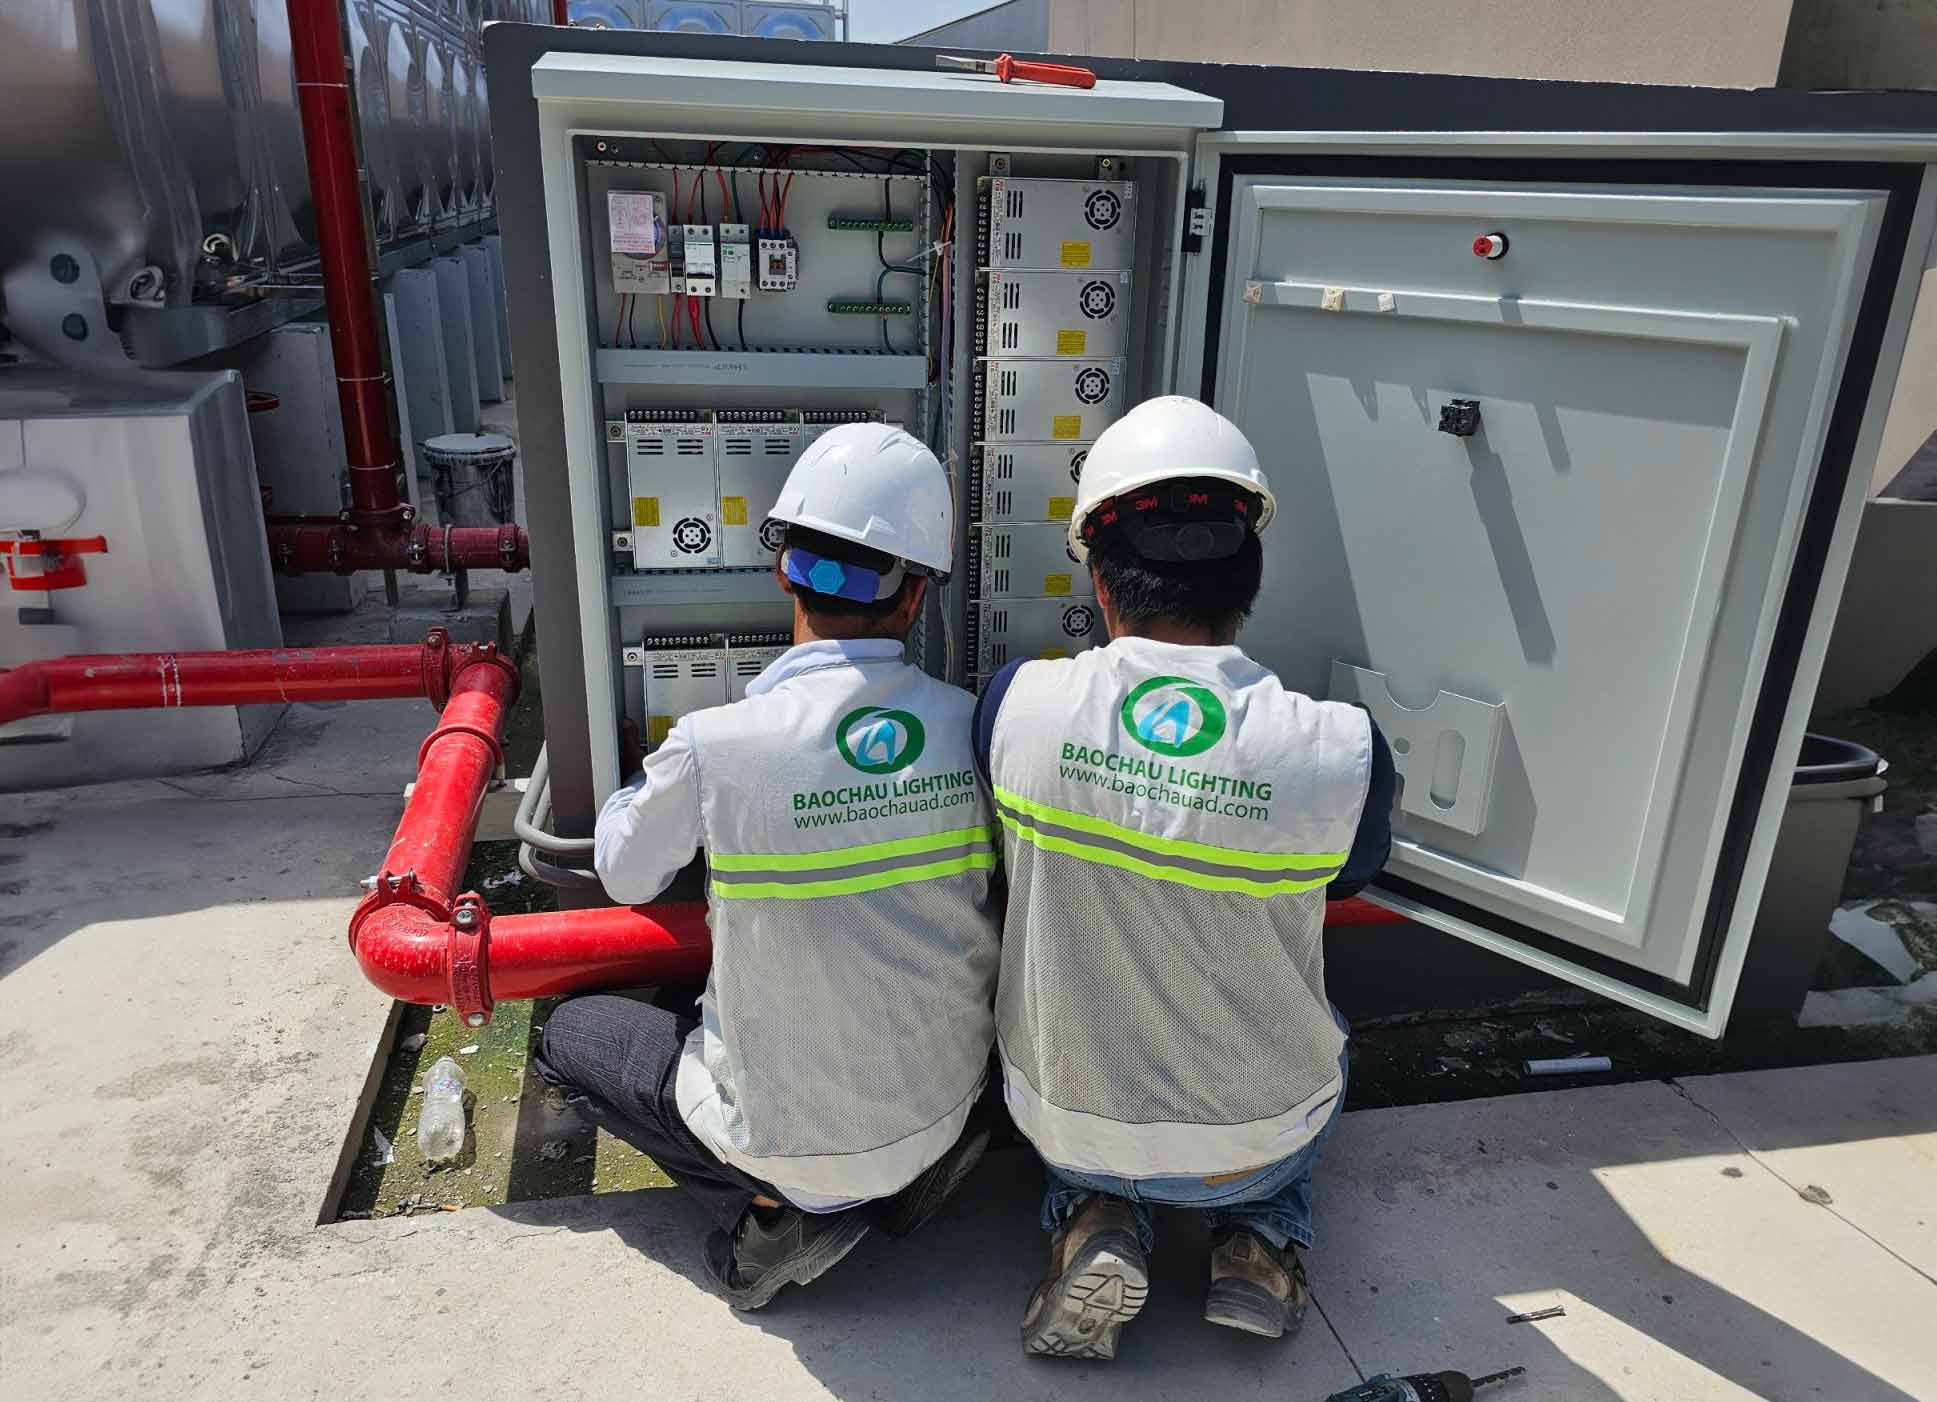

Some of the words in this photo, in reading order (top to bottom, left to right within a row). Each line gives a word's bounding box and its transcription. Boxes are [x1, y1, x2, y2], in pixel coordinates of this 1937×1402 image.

[1136, 497, 1159, 511] 3M
[793, 783, 888, 810] BAOCHAU
[893, 770, 974, 797] LIGHTING
[1061, 742, 1163, 781] BAOCHAU
[1167, 766, 1272, 801] LIGHTING
[794, 791, 976, 829] www.baochauad.com
[1058, 764, 1269, 821] www.baochauad.com
